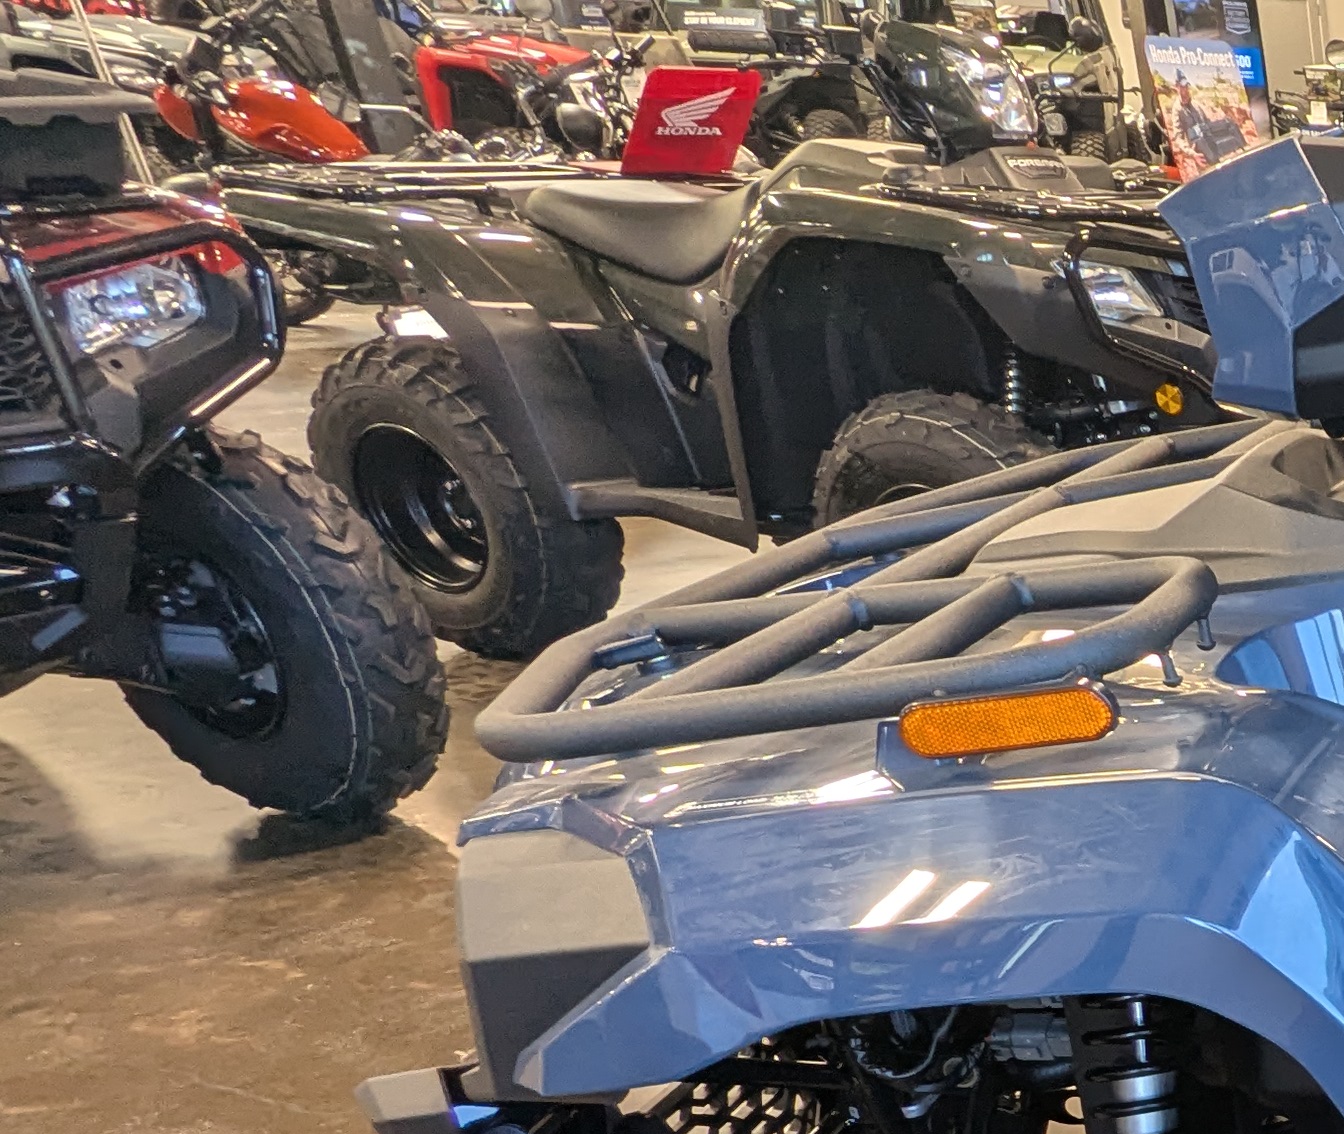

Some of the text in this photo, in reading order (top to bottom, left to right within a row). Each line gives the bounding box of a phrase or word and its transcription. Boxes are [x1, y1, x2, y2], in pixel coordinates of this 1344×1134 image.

[1148, 44, 1236, 68] Honda Pro-Connect
[655, 126, 722, 136] HONDA
